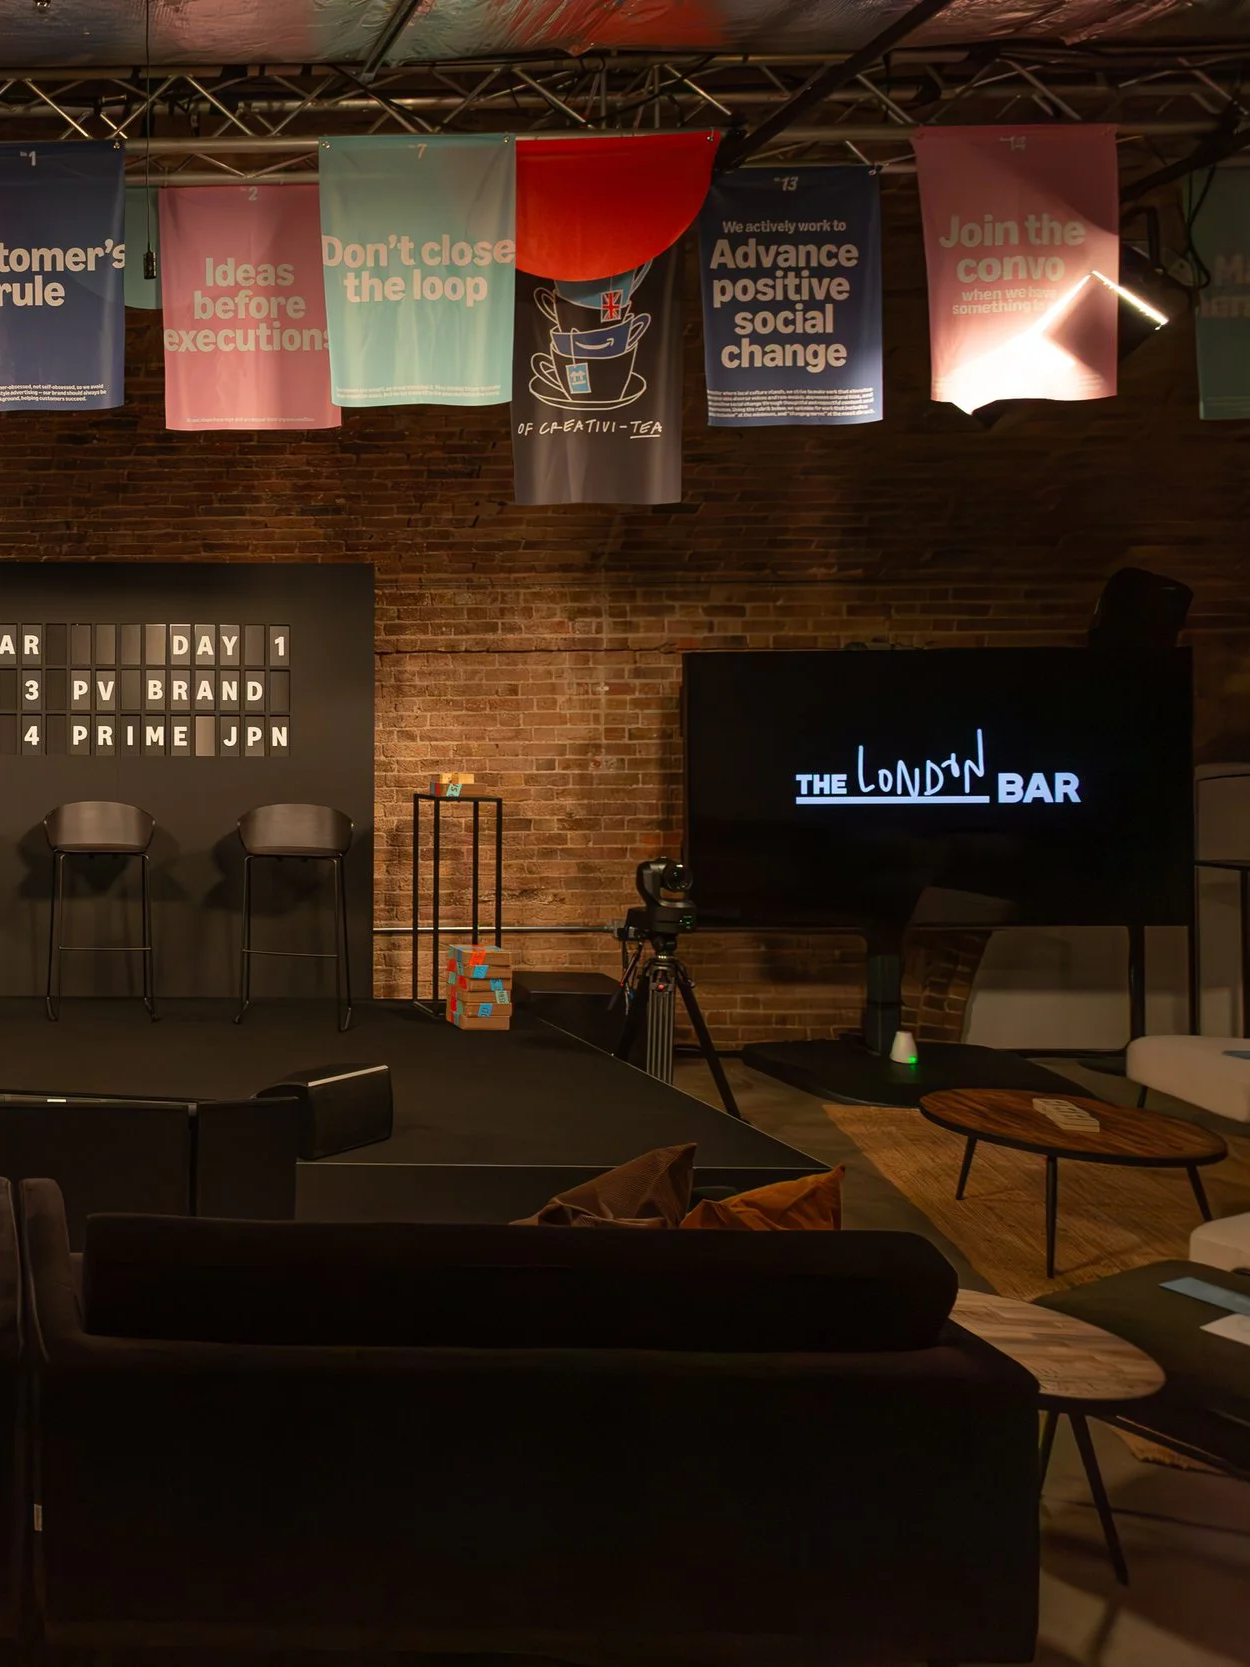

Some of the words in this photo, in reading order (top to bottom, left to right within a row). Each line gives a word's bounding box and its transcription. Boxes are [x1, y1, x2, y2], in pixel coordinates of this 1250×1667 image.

[781, 176, 798, 191] 13
[722, 221, 743, 233] We
[746, 221, 796, 234] actively
[798, 220, 831, 231] work
[833, 220, 846, 231] to
[939, 214, 1019, 248] Join
[1024, 213, 1086, 246] the
[322, 234, 416, 268] Don't
[421, 234, 516, 266] close
[710, 238, 859, 269] Advance
[206, 257, 295, 287] Ideas
[956, 255, 1065, 283] convo
[343, 271, 406, 303] the
[413, 268, 488, 307] loop
[713, 269, 850, 308] positive
[962, 288, 1001, 302] when
[1005, 288, 1026, 298] we
[194, 289, 306, 319] before
[734, 303, 833, 335] social
[953, 300, 1031, 315] something
[721, 338, 847, 373] change
[517, 423, 533, 436] OF
[539, 419, 662, 435] CREATIVI-TEA
[173, 635, 238, 656] DAY
[275, 636, 285, 656] 1
[25, 680, 39, 700] 3
[73, 680, 114, 701] PV
[148, 680, 263, 701] BRAND
[24, 726, 39, 745] 4
[73, 726, 188, 746] PRIME
[223, 726, 288, 746] JPN
[796, 774, 847, 794] THE
[998, 773, 1081, 803] BAR
